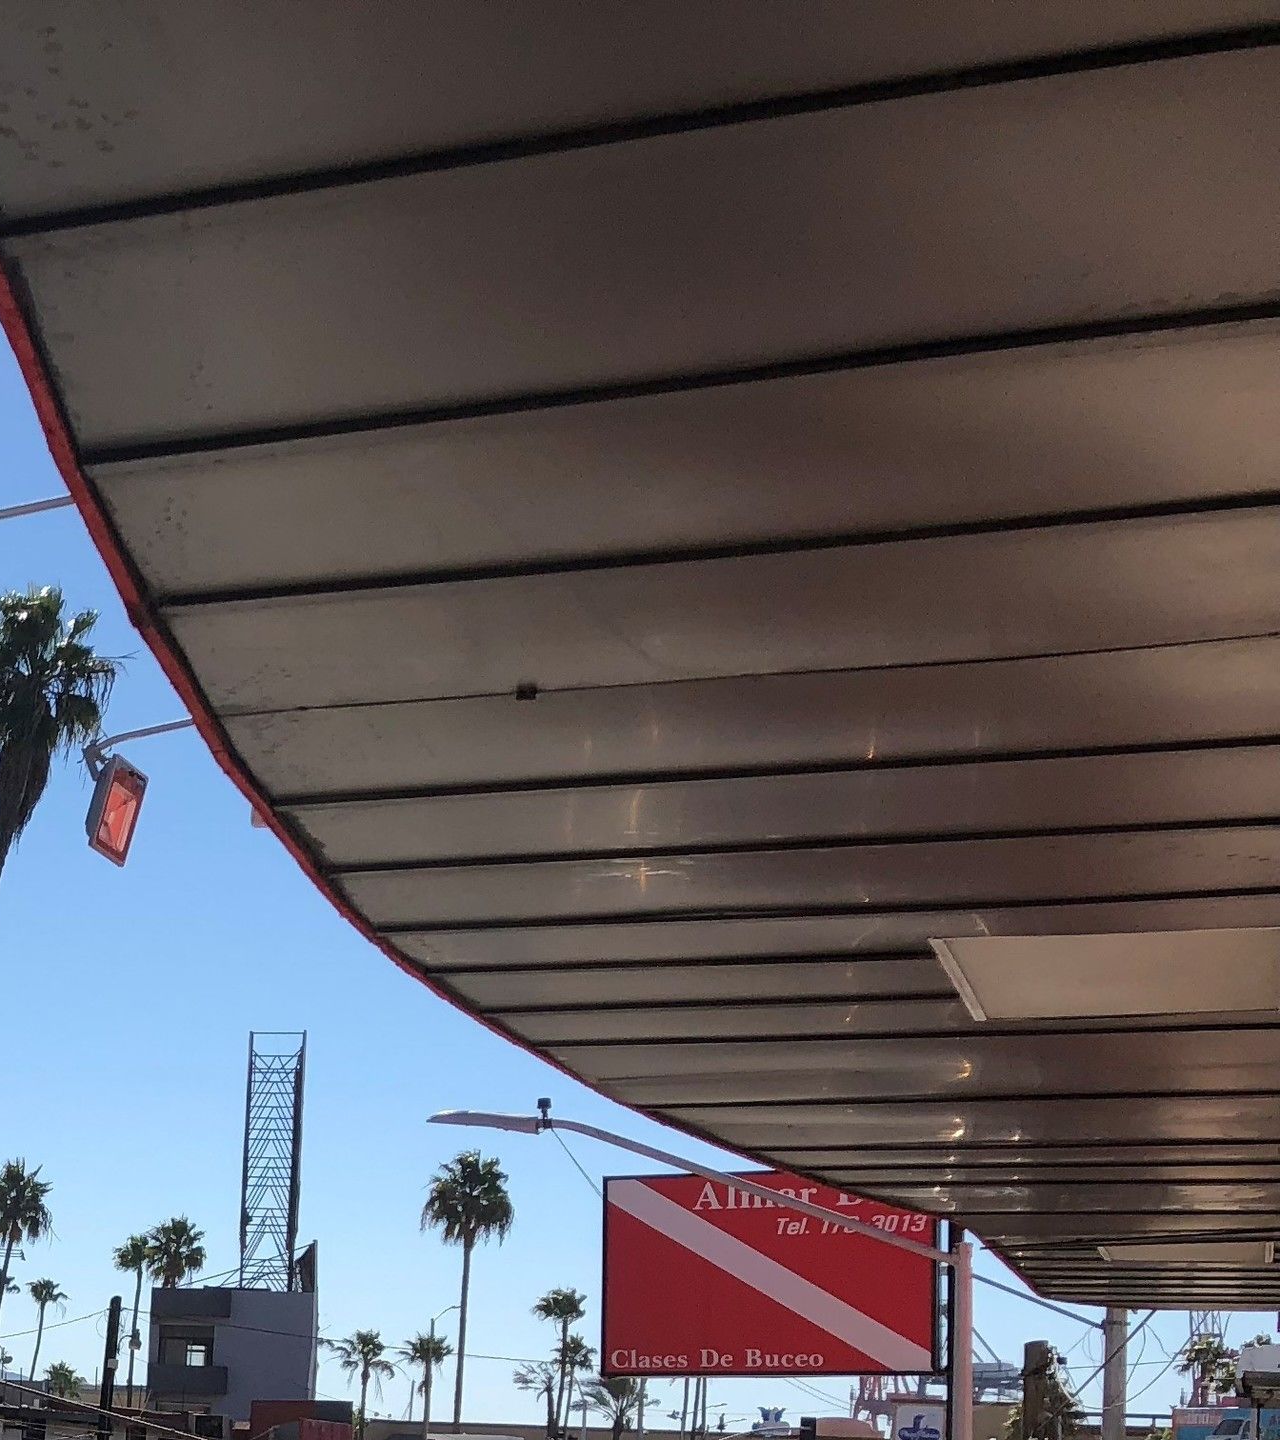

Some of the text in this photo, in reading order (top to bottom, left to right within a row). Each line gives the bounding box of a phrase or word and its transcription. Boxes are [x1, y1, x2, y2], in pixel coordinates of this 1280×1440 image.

[776, 1217, 810, 1235] Tel.
[611, 1349, 824, 1369] Clases De Buceo
